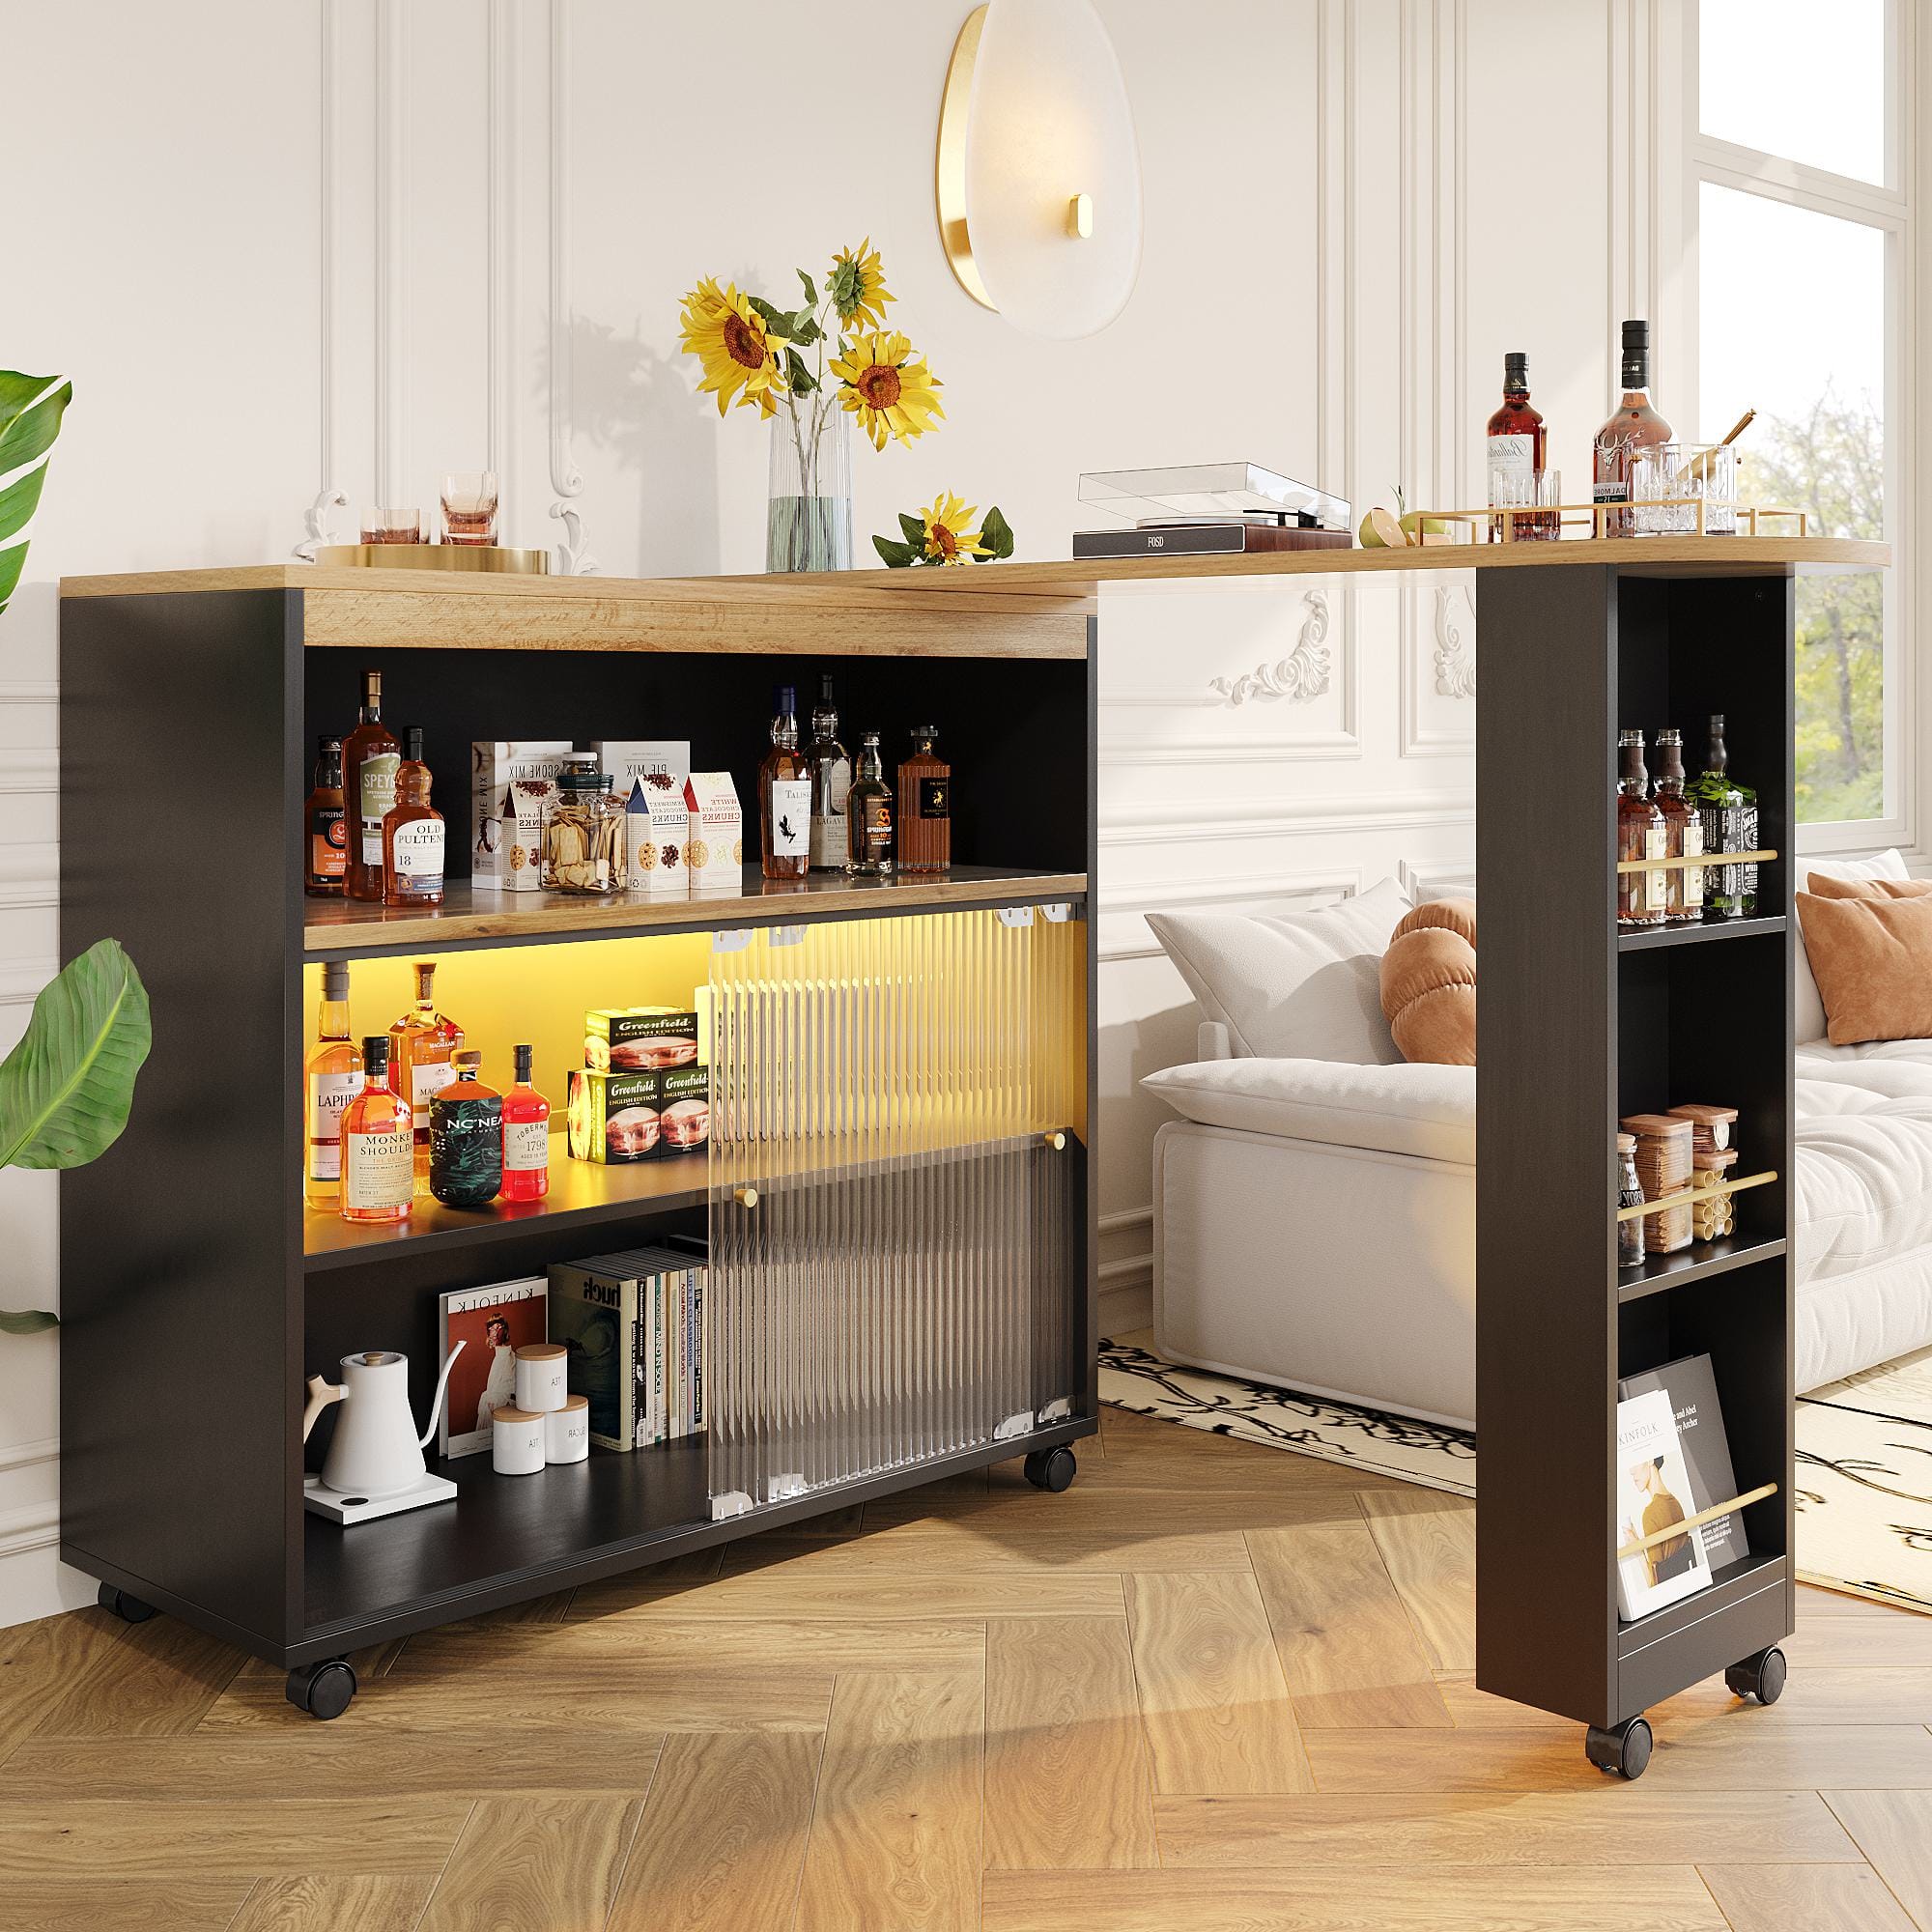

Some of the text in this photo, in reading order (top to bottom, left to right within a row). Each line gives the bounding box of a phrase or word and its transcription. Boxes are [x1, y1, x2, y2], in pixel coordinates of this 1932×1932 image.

[1148, 536, 1164, 548] FOSD
[416, 825, 440, 834] OLD
[399, 855, 412, 866] 18
[618, 1017, 690, 1031] Greenfield
[611, 1078, 654, 1096] Greenfield
[666, 1072, 707, 1090] Greenfield
[609, 1094, 658, 1106] ENGLISH EDITION
[664, 1090, 687, 1098] ENGLISH
[526, 1139, 546, 1151] 1798
[1676, 1407, 1686, 1420] and
[1686, 1404, 1697, 1416] Abel
[1683, 1418, 1698, 1431] Archer
[1618, 1421, 1659, 1446] KINFOLK
